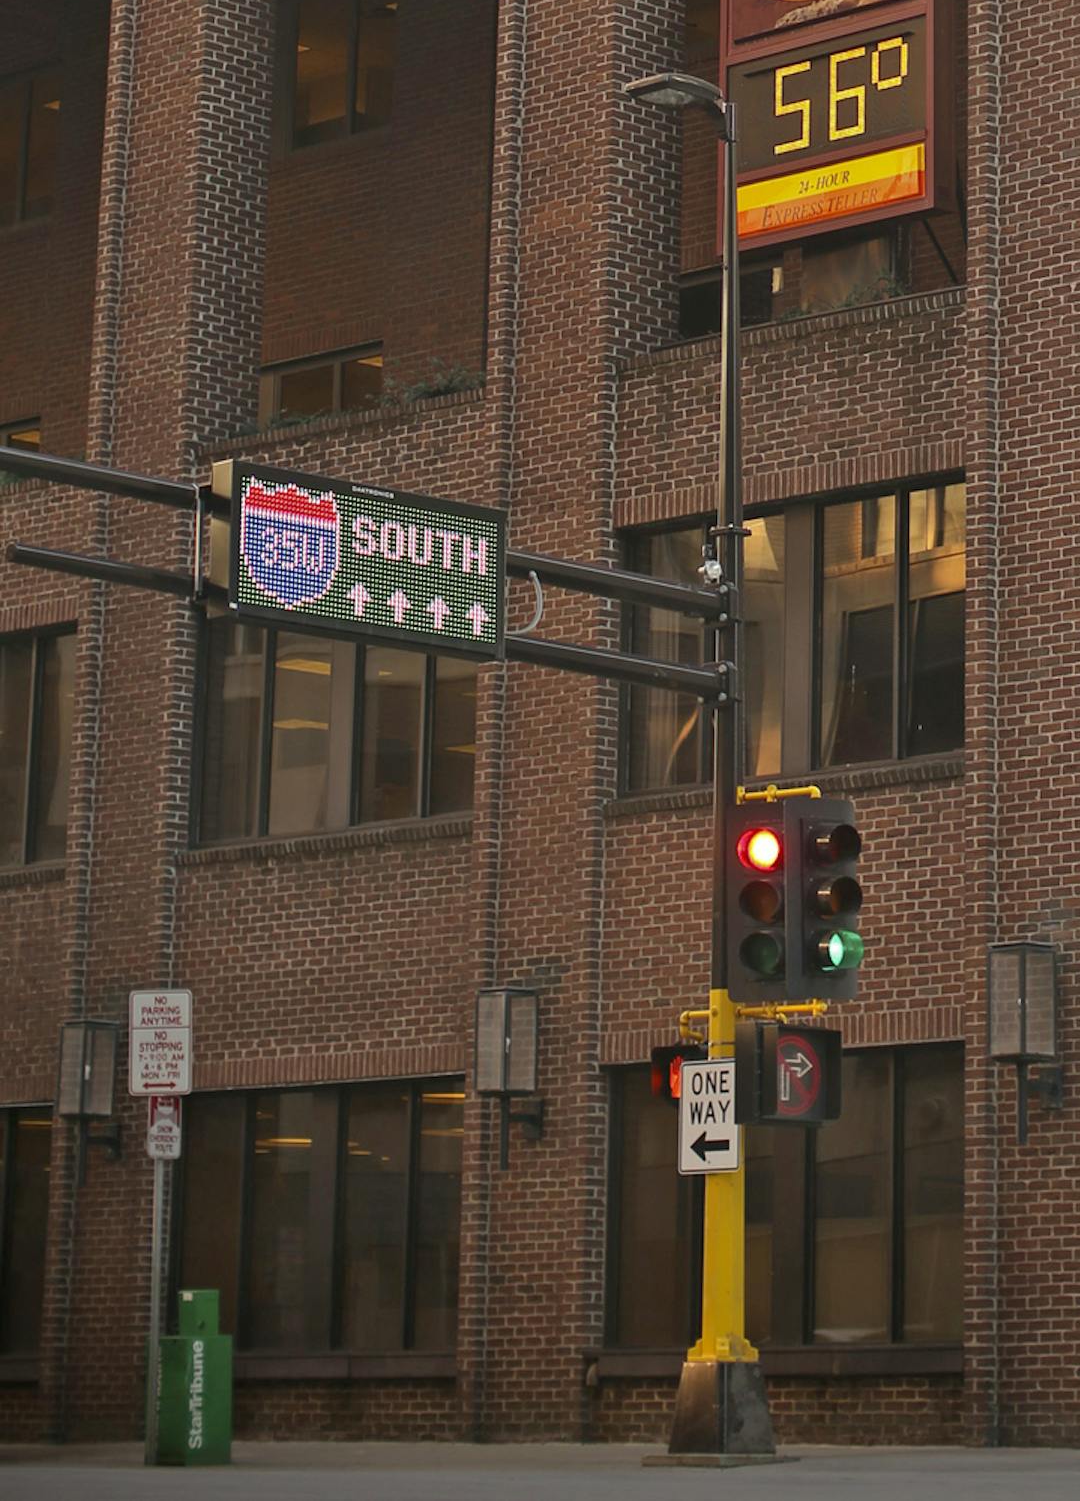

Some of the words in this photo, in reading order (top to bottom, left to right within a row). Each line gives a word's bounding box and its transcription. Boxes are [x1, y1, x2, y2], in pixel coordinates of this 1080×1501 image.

[826, 187, 879, 213] TELLER
[351, 515, 488, 576] SOUTH
[261, 527, 325, 575] 35W
[154, 996, 168, 1005] NO
[141, 1006, 181, 1015] PARKING
[140, 1016, 182, 1026] ANYTIME
[154, 1031, 168, 1041] NO
[139, 1042, 183, 1053] STOPPING
[172, 1053, 185, 1061] AM
[165, 1062, 178, 1070] PM
[141, 1072, 159, 1080] MON
[167, 1071, 180, 1079] FRI
[692, 1070, 730, 1095] ONE
[689, 1100, 731, 1125] WAY
